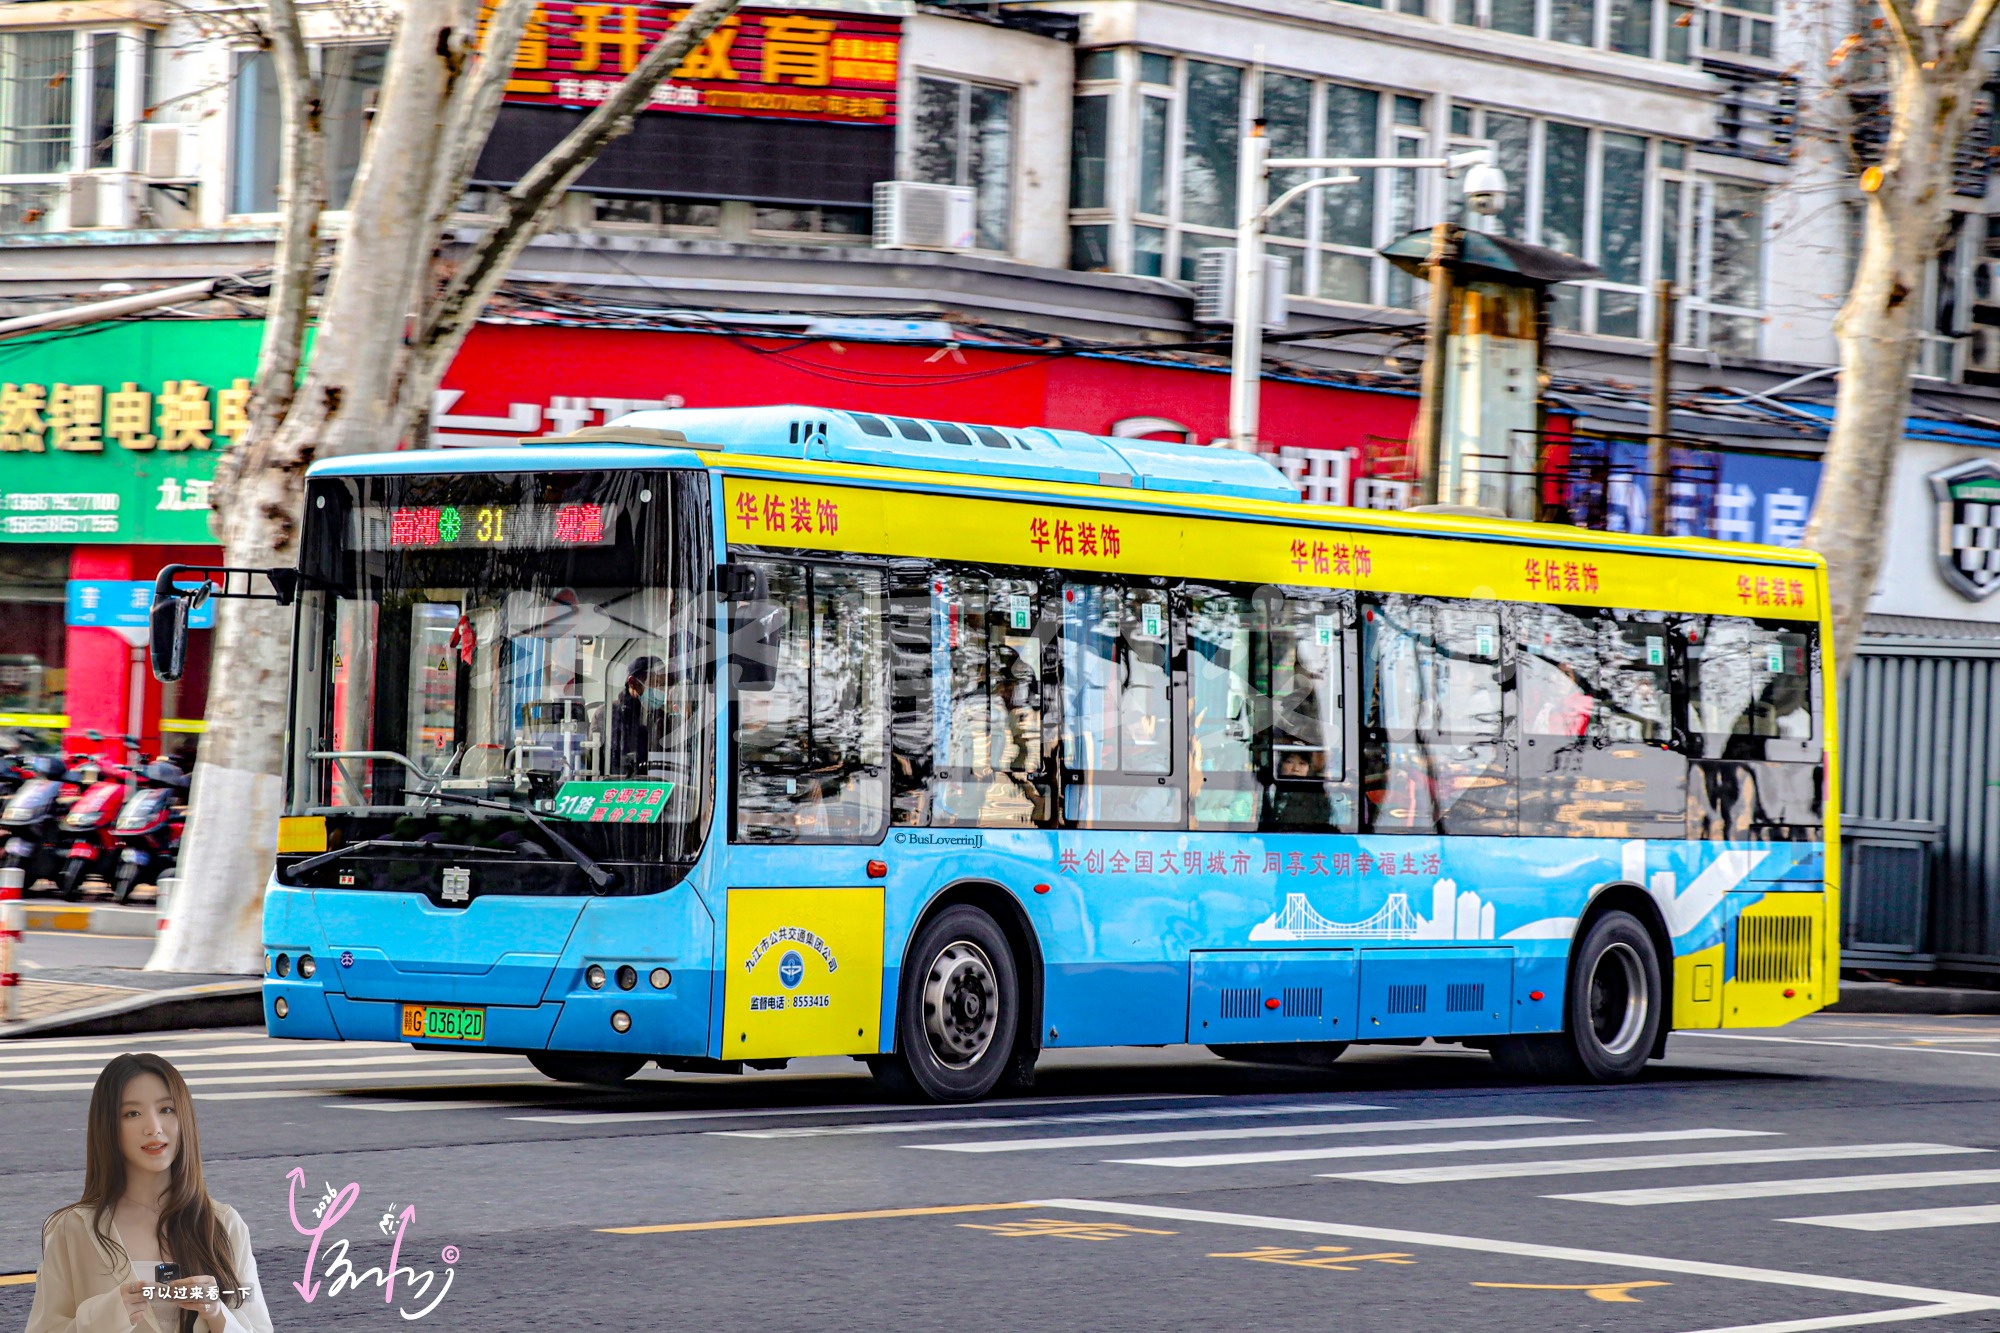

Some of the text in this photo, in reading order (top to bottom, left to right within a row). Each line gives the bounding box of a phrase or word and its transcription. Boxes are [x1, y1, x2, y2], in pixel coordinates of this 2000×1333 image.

[391, 508, 440, 545] 南湖
[476, 509, 503, 542] 31
[736, 491, 838, 536] 华佑装饰
[1030, 517, 1120, 559] 华佑装饰
[1290, 539, 1371, 578] 华佑装饰
[1525, 559, 1599, 595] 华佑装饰
[1737, 574, 1804, 610] 华佑装饰
[556, 795, 596, 815] 31路
[588, 807, 653, 822] 票价2元
[600, 788, 664, 805] 空调开启
[1058, 848, 1441, 876] 共创全国文明城市 同享文明幸福生活
[745, 927, 838, 974] 九江市公共交通集团公司
